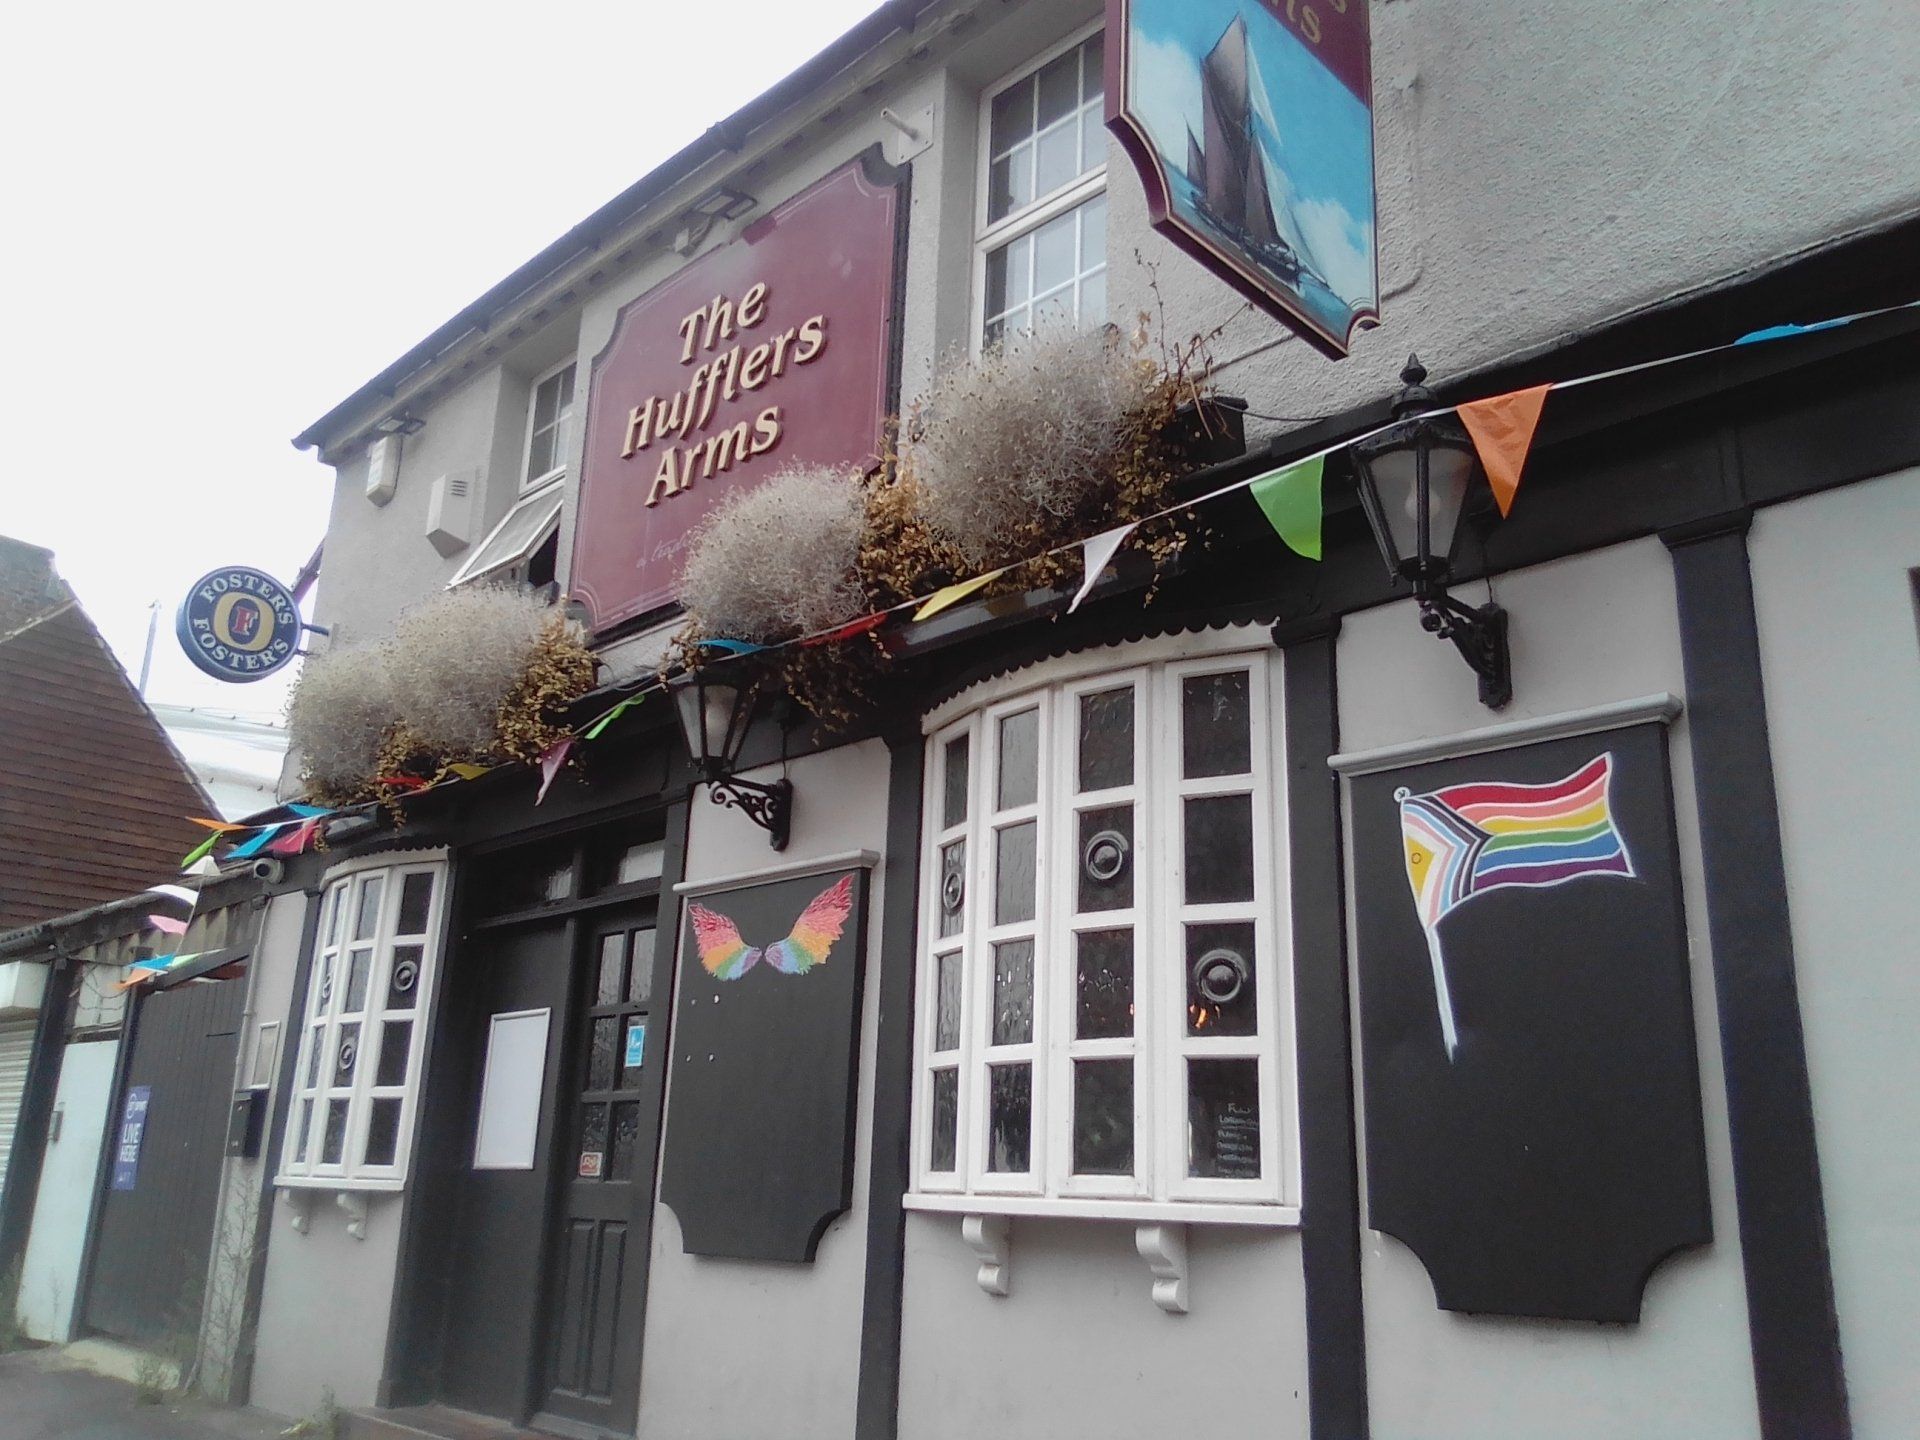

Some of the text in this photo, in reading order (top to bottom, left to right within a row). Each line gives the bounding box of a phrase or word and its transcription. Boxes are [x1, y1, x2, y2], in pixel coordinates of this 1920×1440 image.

[679, 281, 767, 365] The
[620, 314, 828, 460] Hufflers
[643, 405, 783, 508] Arms
[199, 573, 294, 625] FOSTER'S
[193, 617, 289, 670] FOSTER'S
[120, 1145, 137, 1162] HERE
[122, 1123, 141, 1143] LIVE
